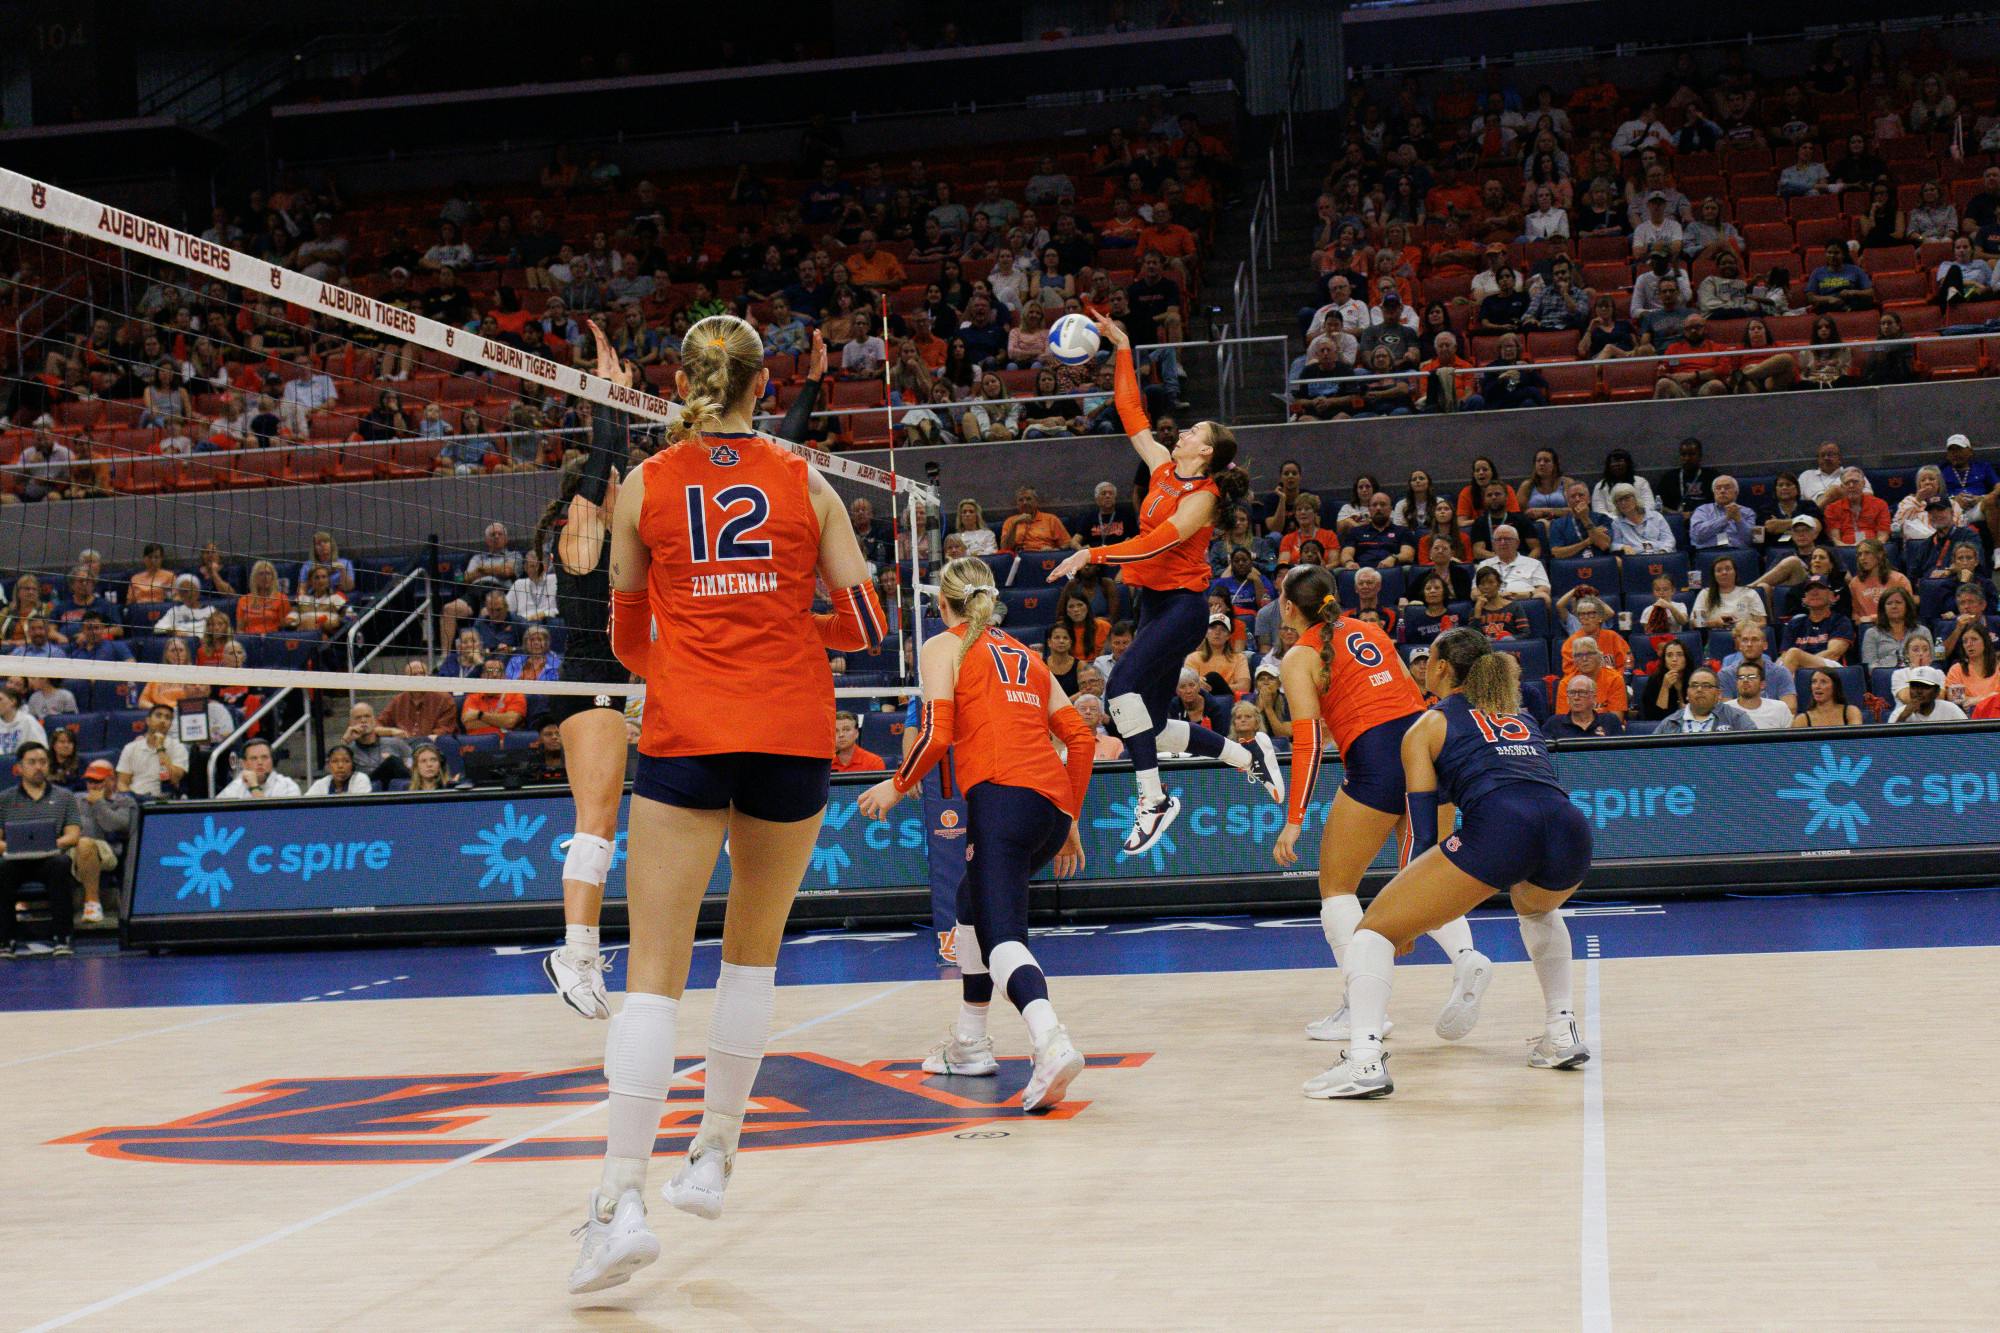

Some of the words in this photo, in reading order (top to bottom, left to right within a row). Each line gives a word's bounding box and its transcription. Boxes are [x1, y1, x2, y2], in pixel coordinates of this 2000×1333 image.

[98, 208, 169, 251] AUBURN
[174, 233, 230, 271] TIGERS
[319, 284, 371, 320] AUBURN
[375, 303, 416, 334] TIGERS
[482, 341, 523, 372] AUBURN
[525, 355, 557, 380] TIGERS
[607, 384, 640, 408] AUBURN
[642, 395, 668, 416] TIGERS
[685, 484, 773, 563] 12
[1147, 495, 1164, 517] 1
[691, 572, 778, 597] ZIMMERMAN
[987, 643, 1030, 686] 17
[1346, 631, 1384, 667] 6
[1468, 709, 1531, 743] 15
[279, 840, 392, 882] spire
